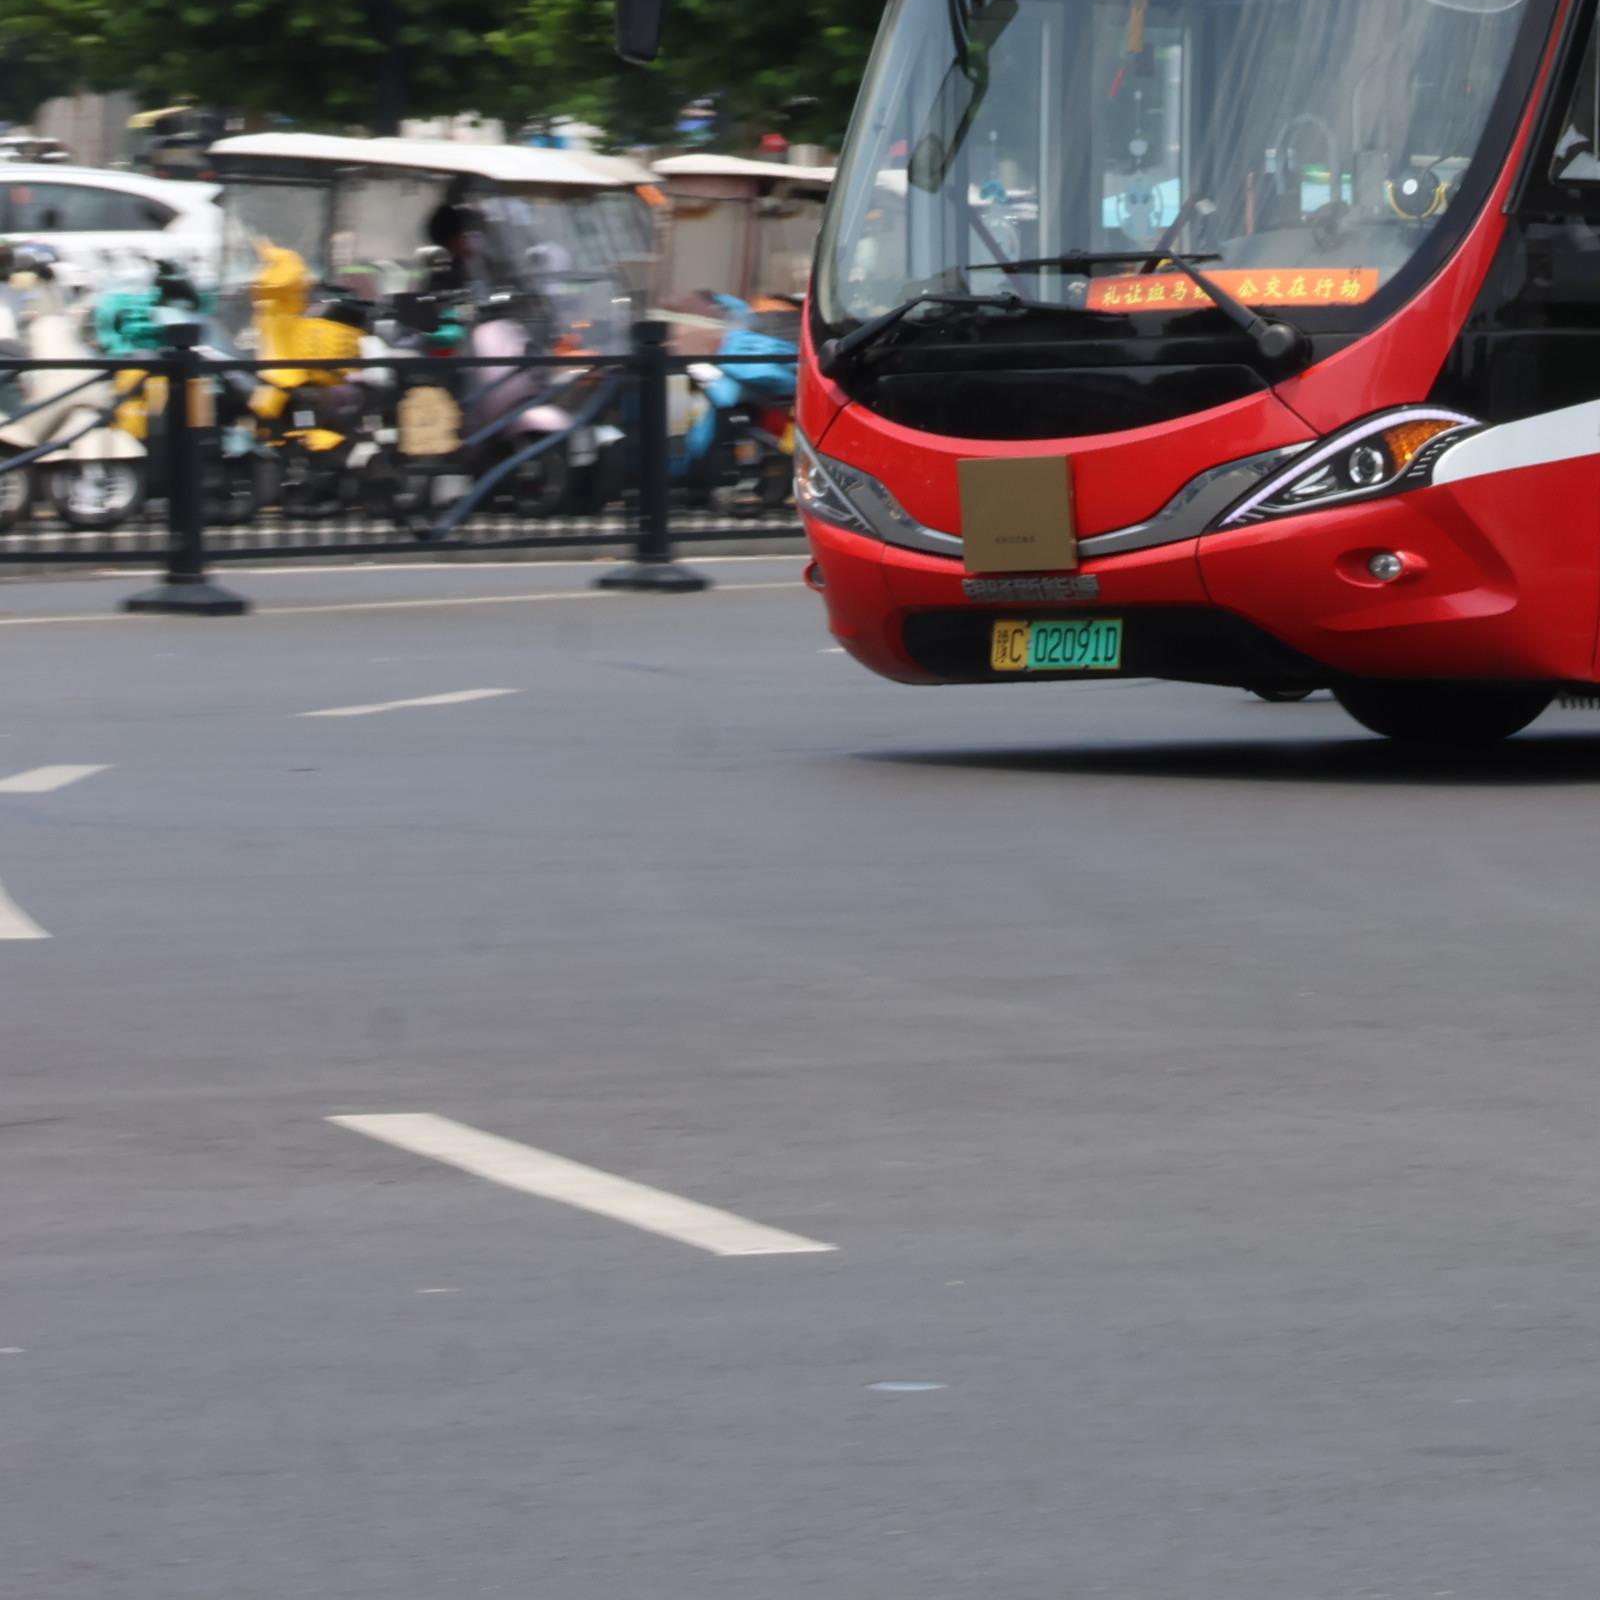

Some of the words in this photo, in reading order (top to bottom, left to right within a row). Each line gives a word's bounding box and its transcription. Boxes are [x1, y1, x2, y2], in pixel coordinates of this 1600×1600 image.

[1237, 276, 1360, 299] 公交在行动
